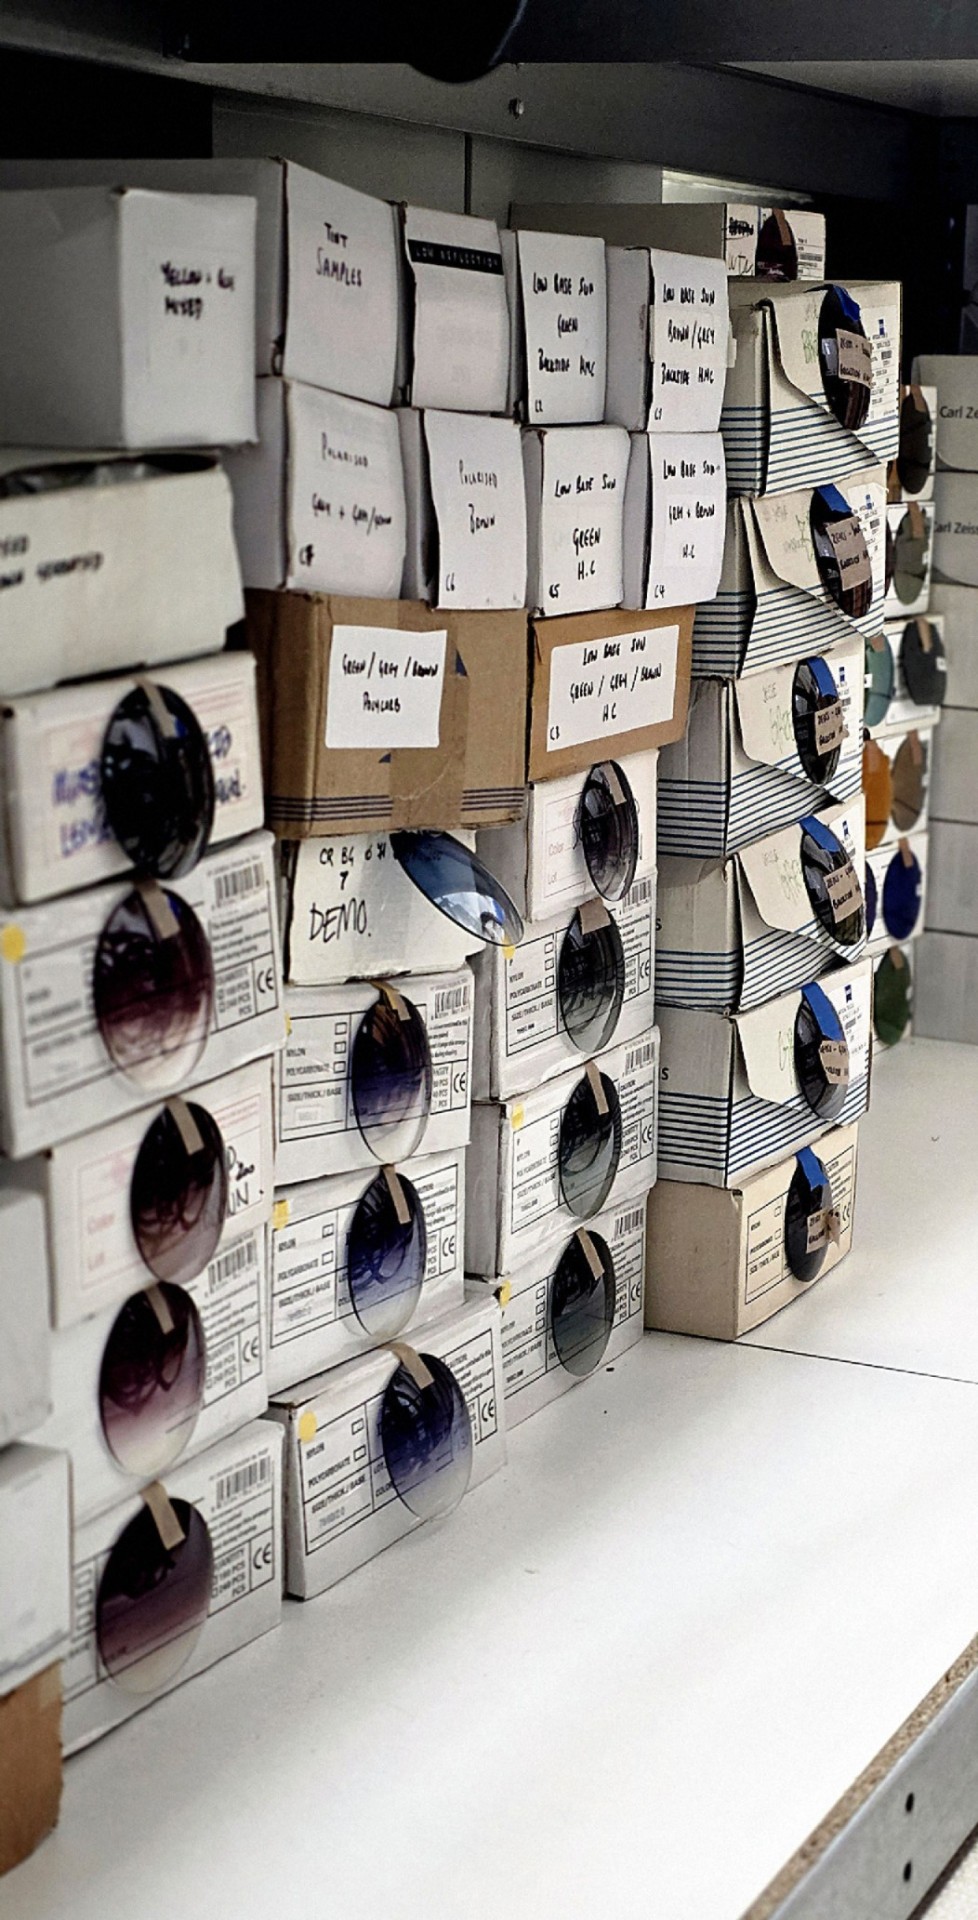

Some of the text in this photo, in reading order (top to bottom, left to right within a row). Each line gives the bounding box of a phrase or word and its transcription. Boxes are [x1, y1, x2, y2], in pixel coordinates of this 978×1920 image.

[316, 247, 362, 288] SAMPLES
[533, 272, 594, 296] LOW BASE SUN
[662, 283, 716, 307] LOW BASE SUN
[940, 406, 963, 418] Carl
[663, 459, 676, 480] LOW
[680, 460, 696, 478] BASE
[554, 473, 616, 498] LOW BASE SUN
[468, 503, 496, 534] BROWN
[572, 527, 601, 556] GREEN
[582, 636, 646, 666] LOW BASE SUN
[570, 681, 594, 704] GREEN
[610, 672, 628, 692] GREY
[319, 847, 334, 867] CR
[257, 968, 274, 994] CE
[453, 1072, 466, 1093] CE
[442, 1236, 455, 1257] CE
[243, 1336, 259, 1363] CE
[481, 1399, 494, 1422] CE
[253, 1543, 271, 1570] CE
